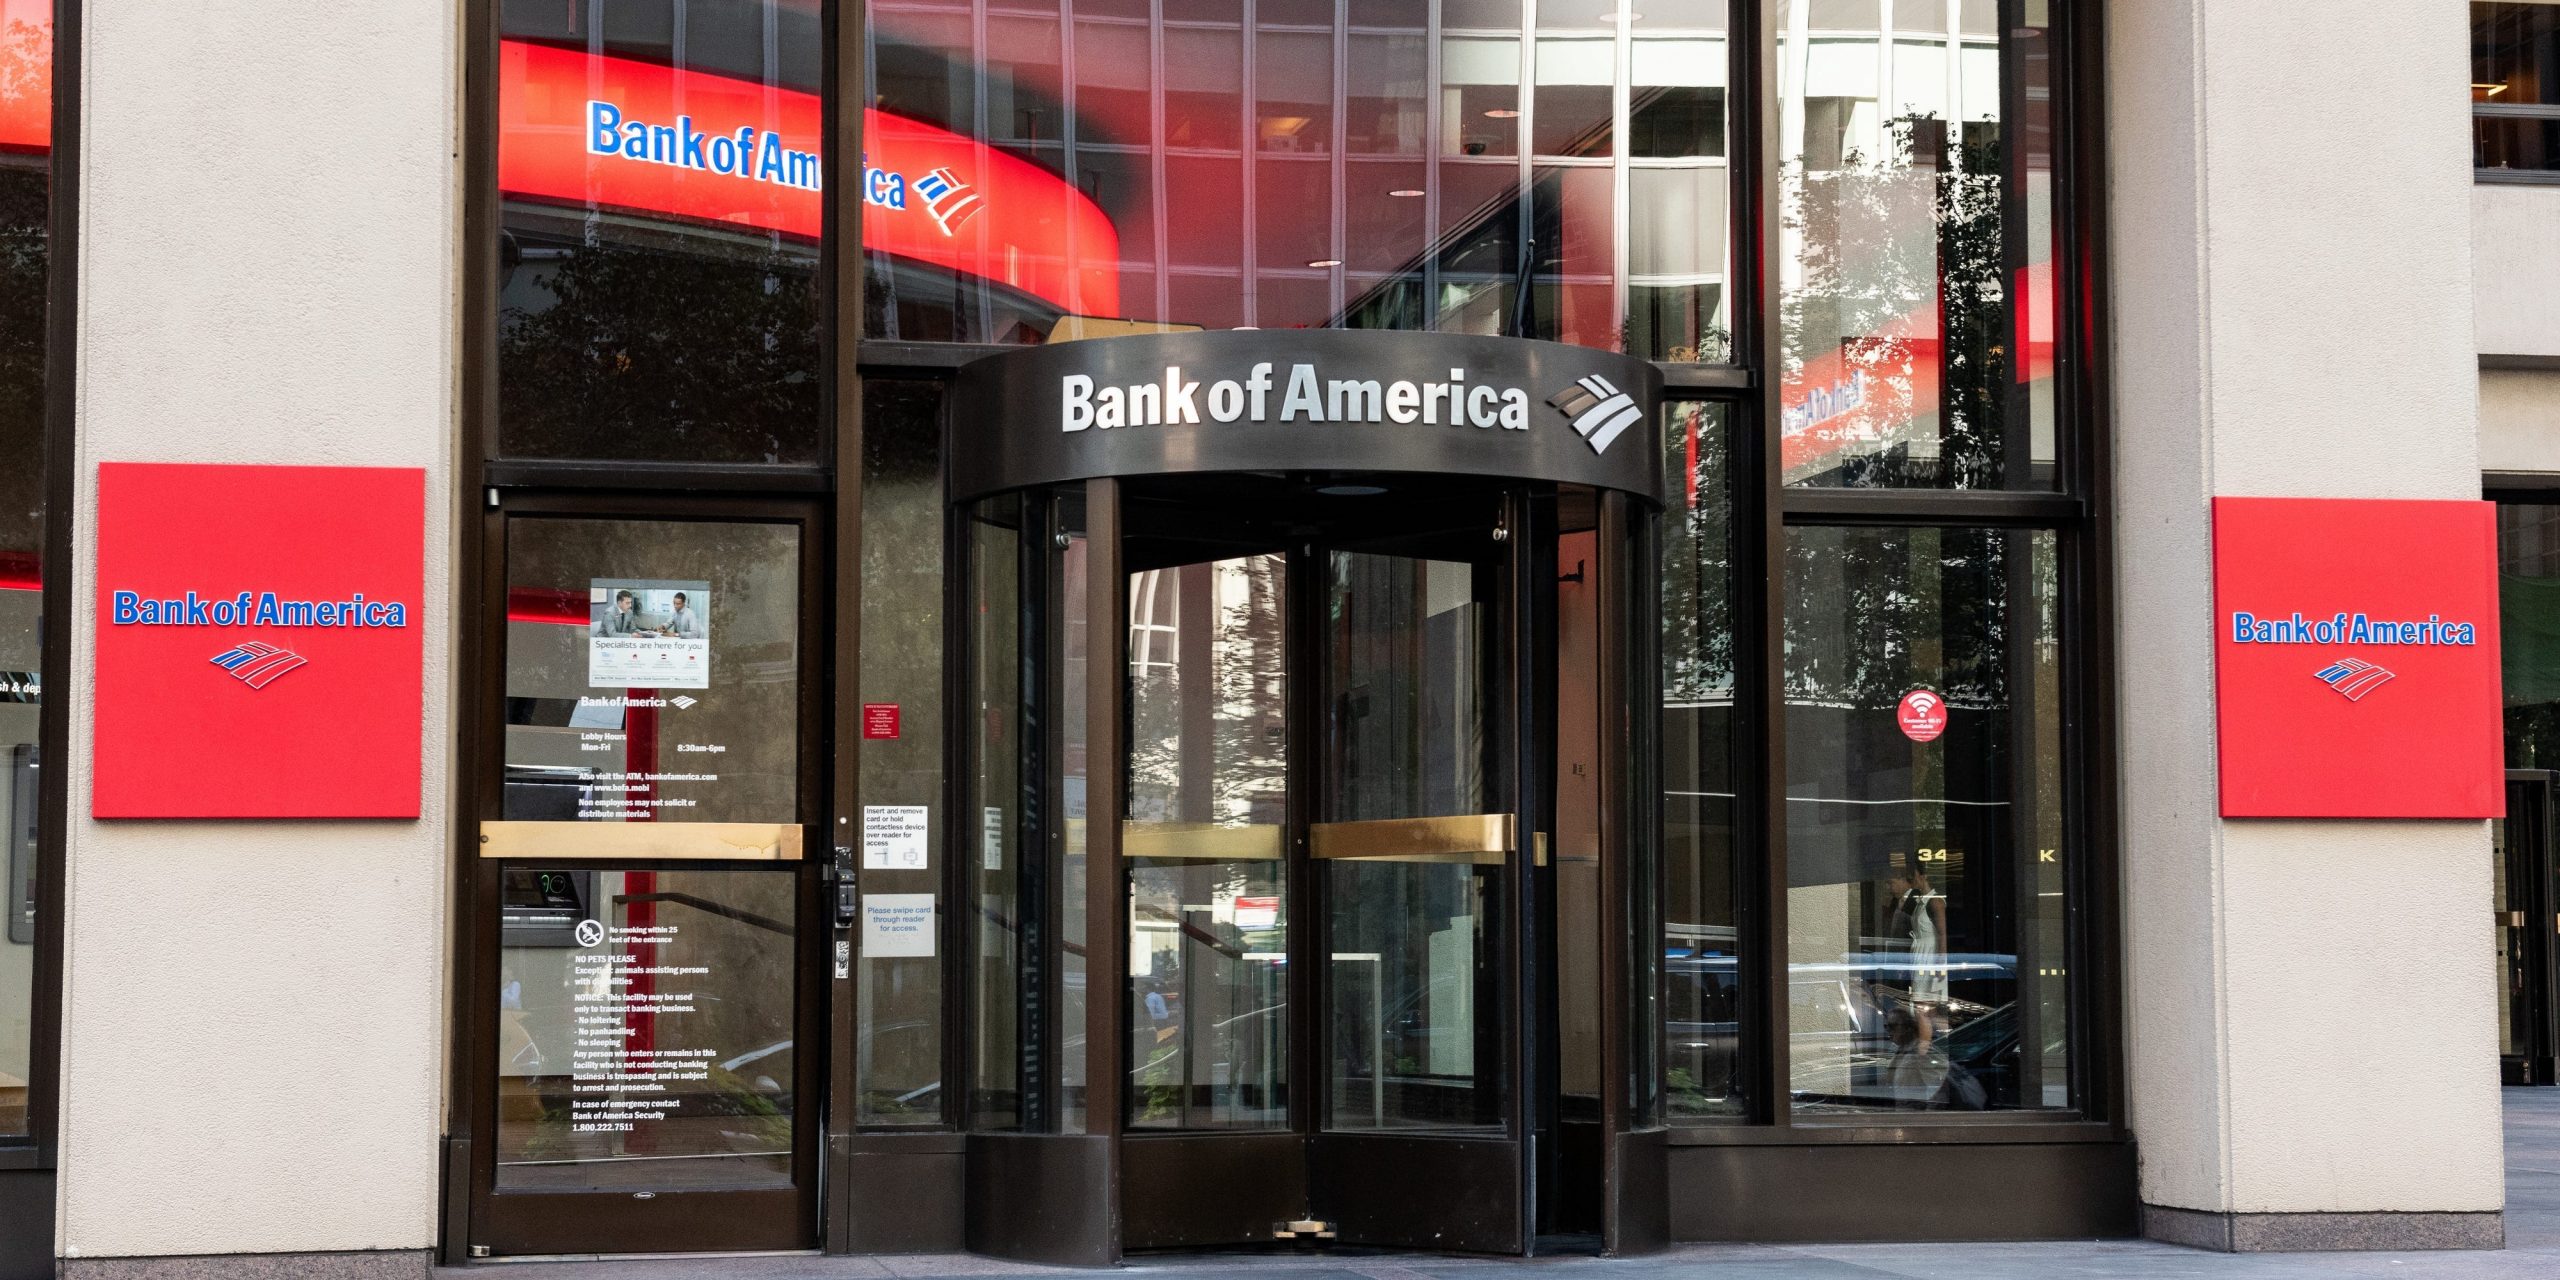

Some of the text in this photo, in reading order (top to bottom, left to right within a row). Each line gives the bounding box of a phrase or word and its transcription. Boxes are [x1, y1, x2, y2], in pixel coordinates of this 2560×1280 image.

[586, 100, 906, 210] Bank of Amica
[1062, 362, 1529, 432] Bank of America
[113, 590, 406, 627] Bank of America
[2232, 611, 2475, 645] Bank of America
[595, 641, 637, 650] Specialists
[654, 641, 671, 649] here
[674, 641, 686, 650] for
[688, 643, 703, 651] you
[11, 682, 21, 693] &
[23, 682, 41, 695] dep
[580, 696, 667, 708] Bank of America
[581, 733, 603, 741] Lobby
[581, 743, 725, 753] Mon-Fri 8:30am-6pm
[626, 773, 644, 781] ATM,
[645, 773, 717, 781] bankofamerica.com
[579, 784, 649, 792] and www.bofa.mobi
[594, 799, 633, 807] employees
[578, 810, 650, 818] distribute materials
[1918, 849, 1947, 861] 34
[893, 907, 914, 915] swipe
[915, 906, 931, 914] card
[873, 915, 925, 924] through reader
[575, 955, 636, 963] NO PETS PLEASE
[645, 967, 679, 975] assisting
[679, 967, 709, 975] persons
[623, 994, 647, 1002] facility
[631, 1005, 661, 1013] banking
[590, 1017, 621, 1025] loitering
[590, 1028, 636, 1036] panhandling
[590, 1039, 621, 1047] sleeping
[573, 1050, 587, 1058] Any
[573, 1061, 599, 1070] facility
[600, 1061, 614, 1069] who
[637, 1061, 677, 1069] conducting
[678, 1060, 708, 1069] banking
[614, 1072, 657, 1081] trespassing
[680, 1071, 708, 1080] subject
[620, 1084, 666, 1092] prosecution.
[601, 1100, 609, 1108] of
[610, 1101, 650, 1109] emergency
[634, 1111, 665, 1120] Security
